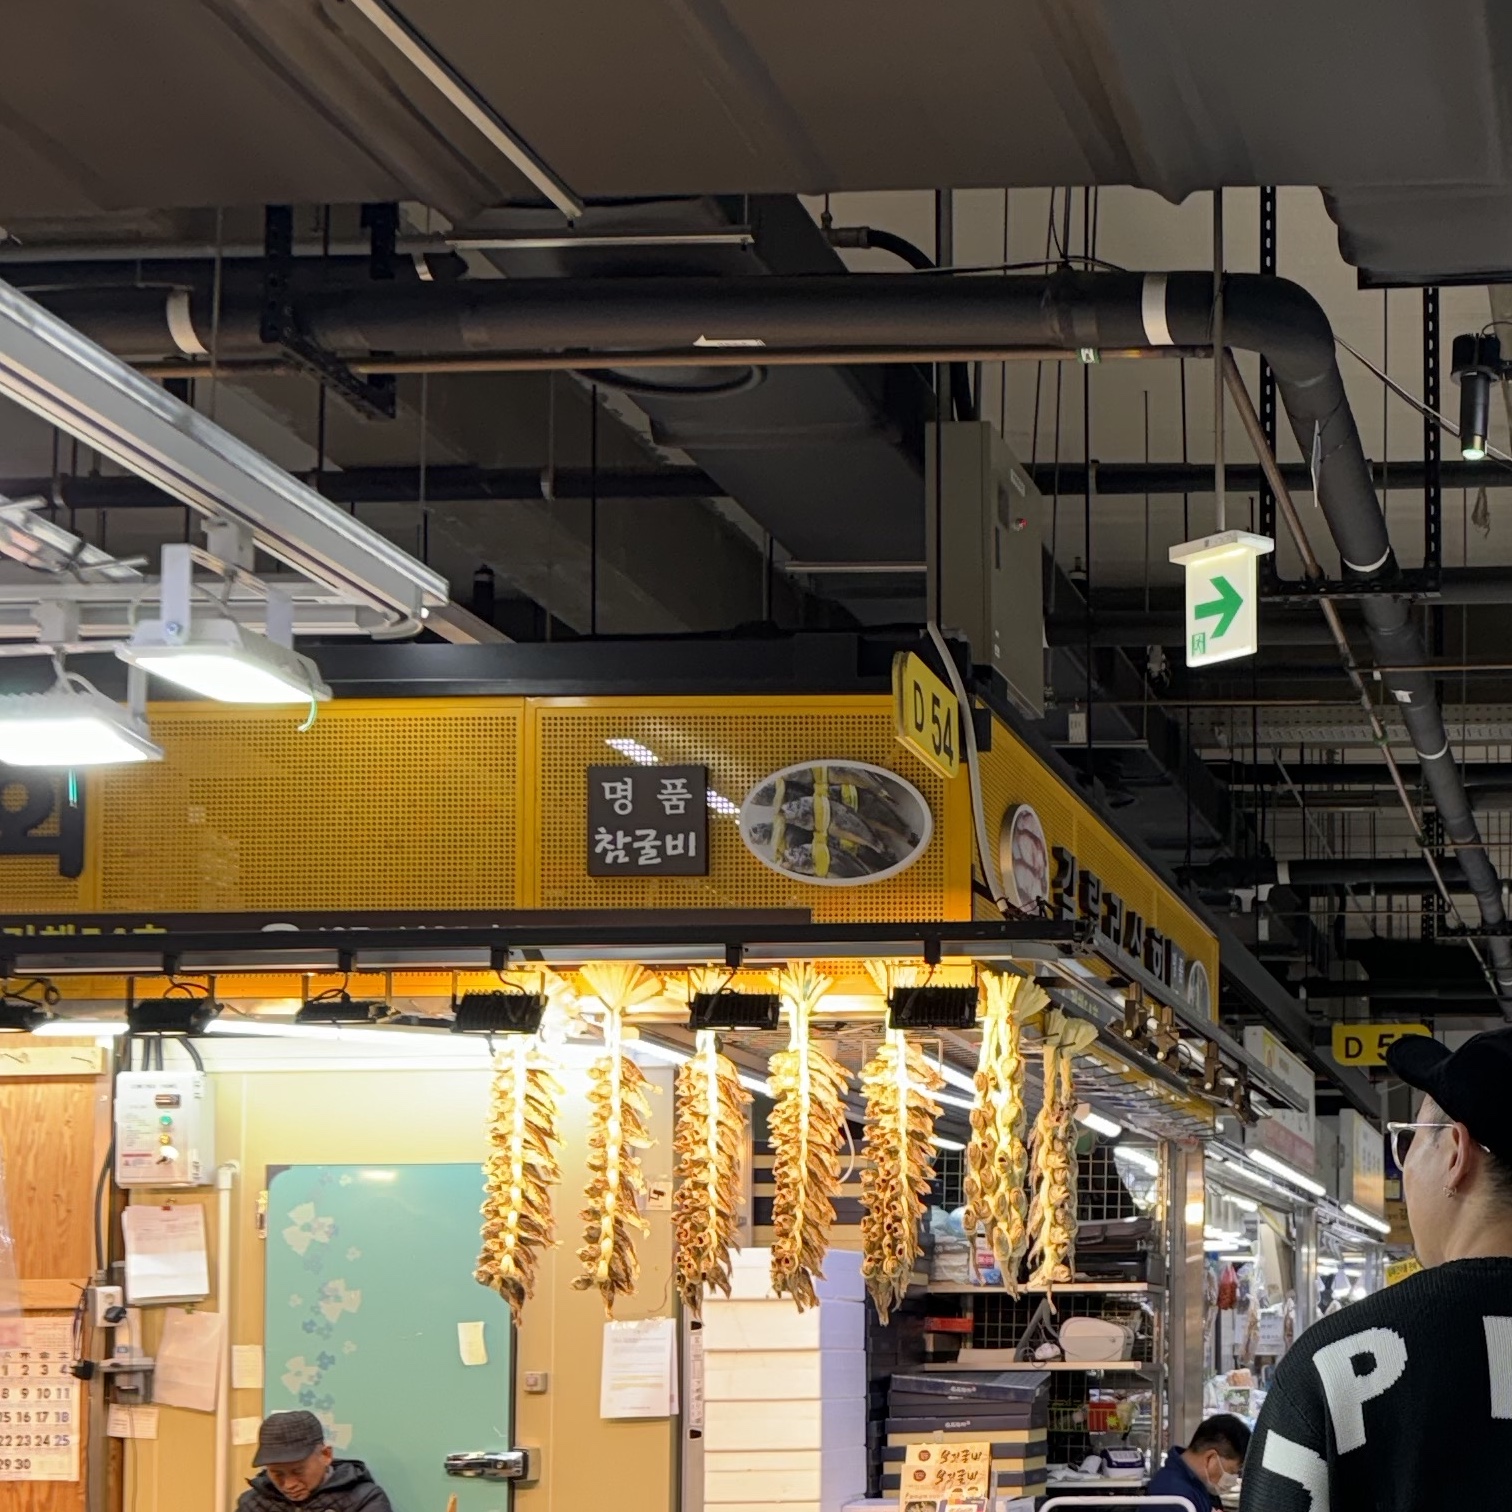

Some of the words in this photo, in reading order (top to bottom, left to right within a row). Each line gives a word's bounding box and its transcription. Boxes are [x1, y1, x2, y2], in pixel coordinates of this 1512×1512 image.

[913, 679, 925, 733] D
[931, 692, 954, 768] 54
[594, 827, 698, 867] 참굴비
[1344, 1036, 1363, 1059] D
[21, 1364, 31, 1376] 2
[40, 1364, 50, 1376] 3
[1, 1387, 10, 1399] 8
[20, 1387, 30, 1399] 9
[36, 1387, 52, 1399] 10
[55, 1387, 71, 1399] 11
[16, 1410, 31, 1423] 16
[35, 1410, 50, 1423] 17
[54, 1410, 70, 1423] 18
[16, 1434, 32, 1447] 23
[34, 1434, 50, 1447] 24
[54, 1434, 71, 1447] 25
[14, 1458, 31, 1470] 30
